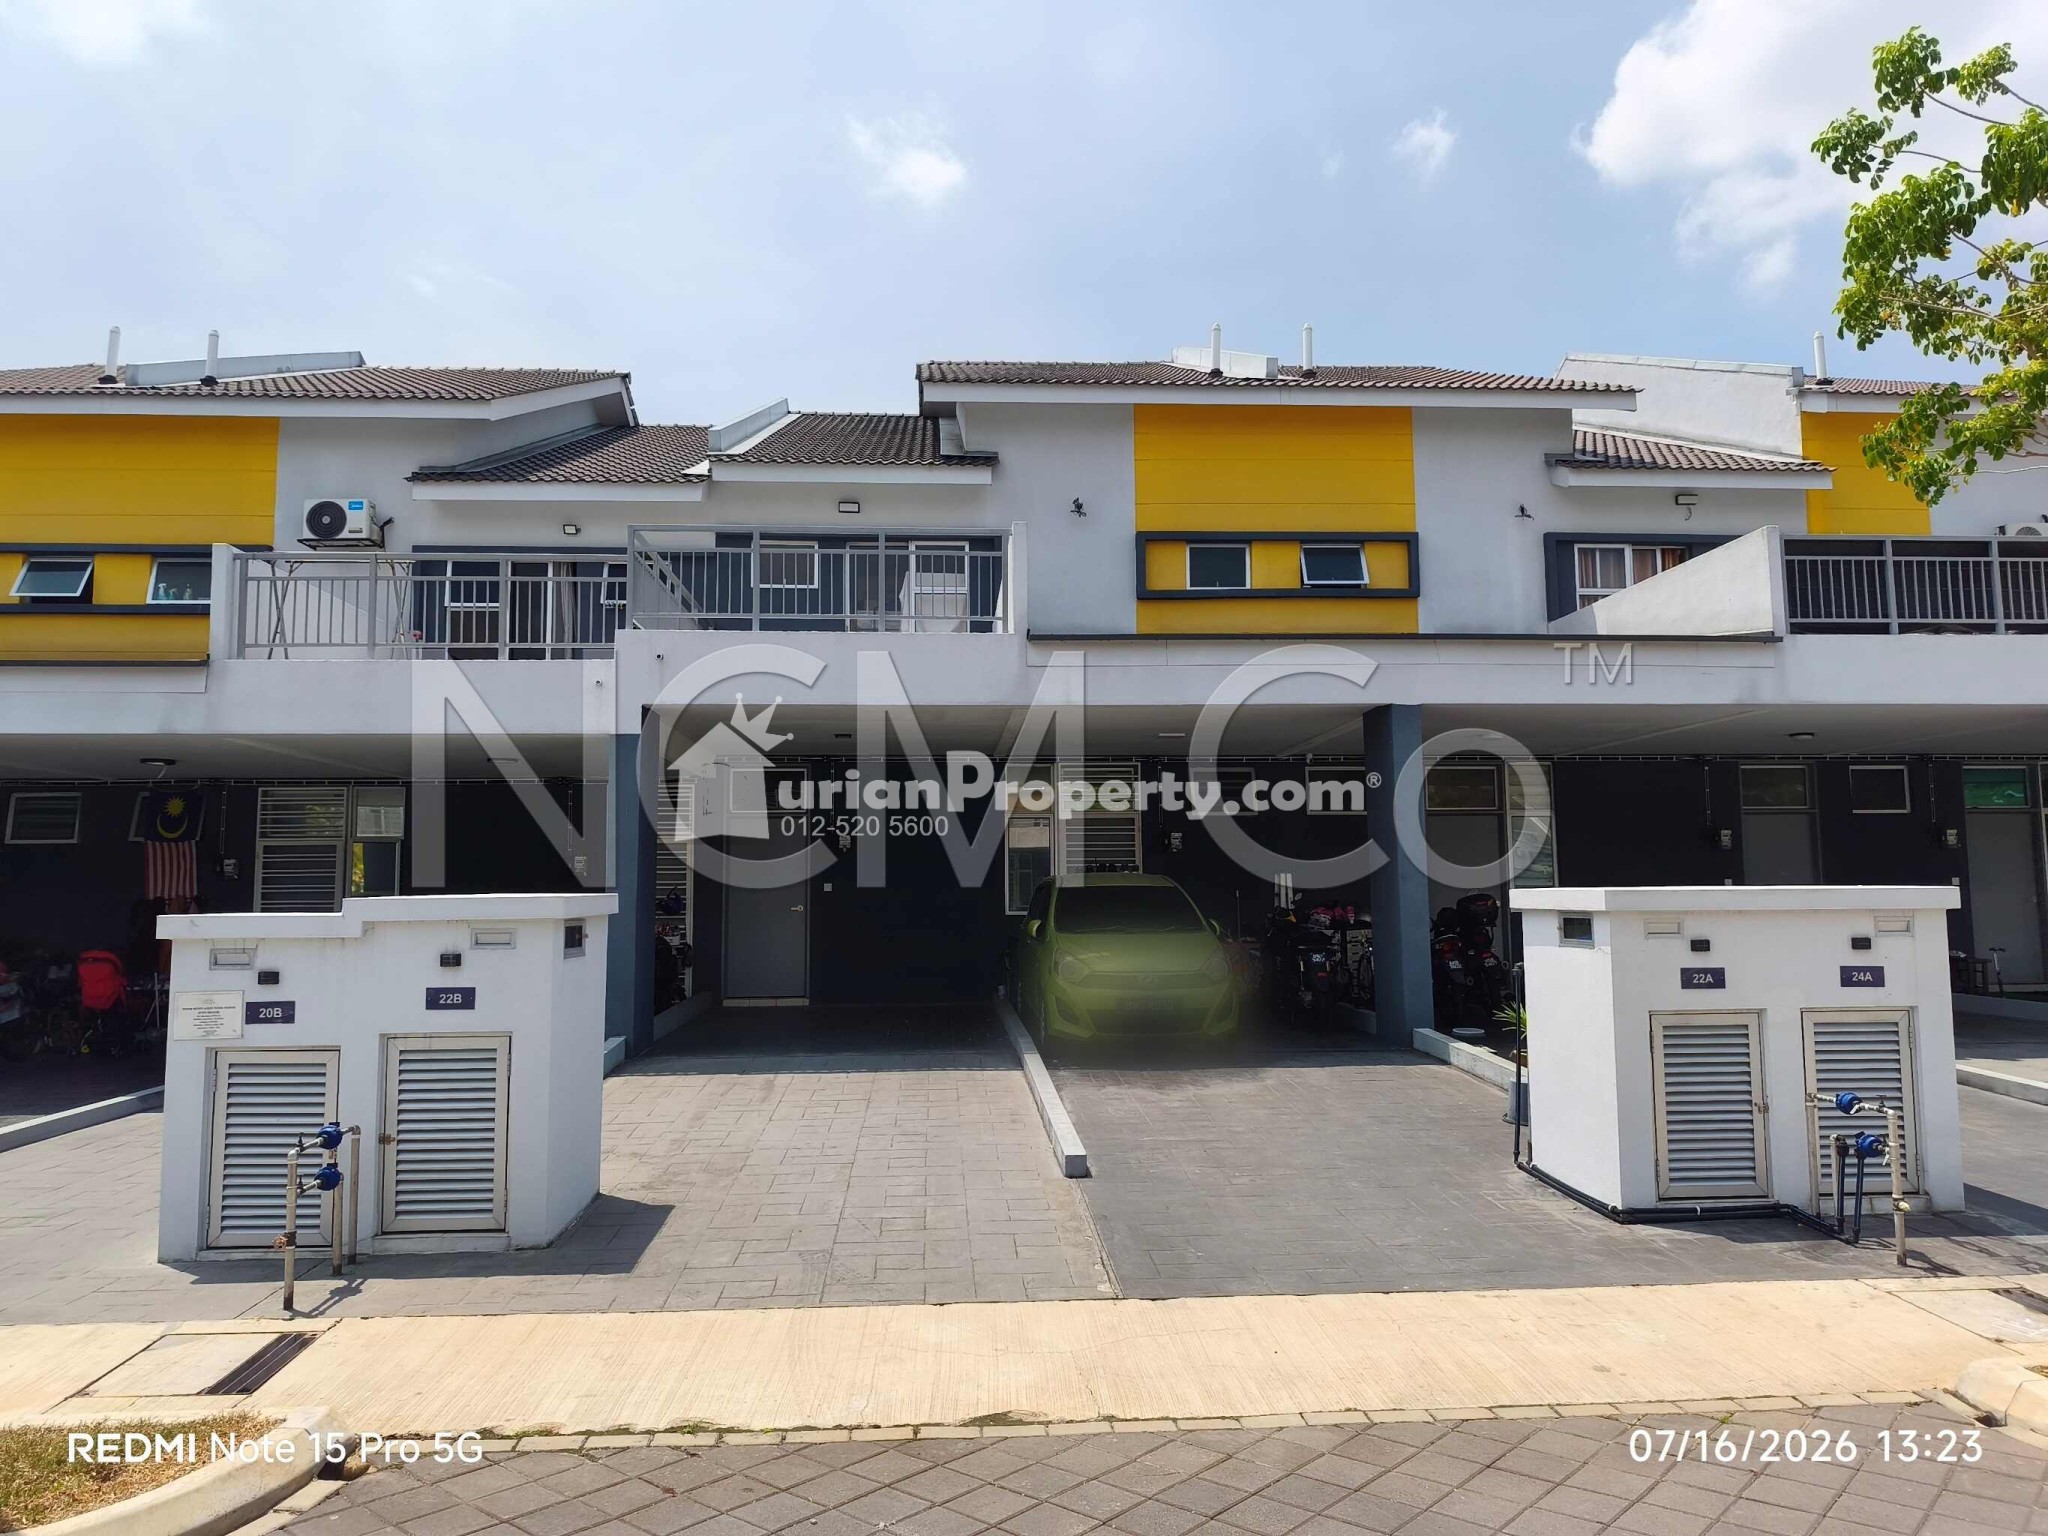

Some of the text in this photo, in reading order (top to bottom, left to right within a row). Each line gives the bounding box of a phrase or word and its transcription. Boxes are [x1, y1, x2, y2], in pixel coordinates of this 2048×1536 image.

[1692, 973, 1713, 984] 22A
[1851, 971, 1873, 982] 24A
[439, 993, 462, 1004] 22B
[259, 1007, 282, 1018] 20B
